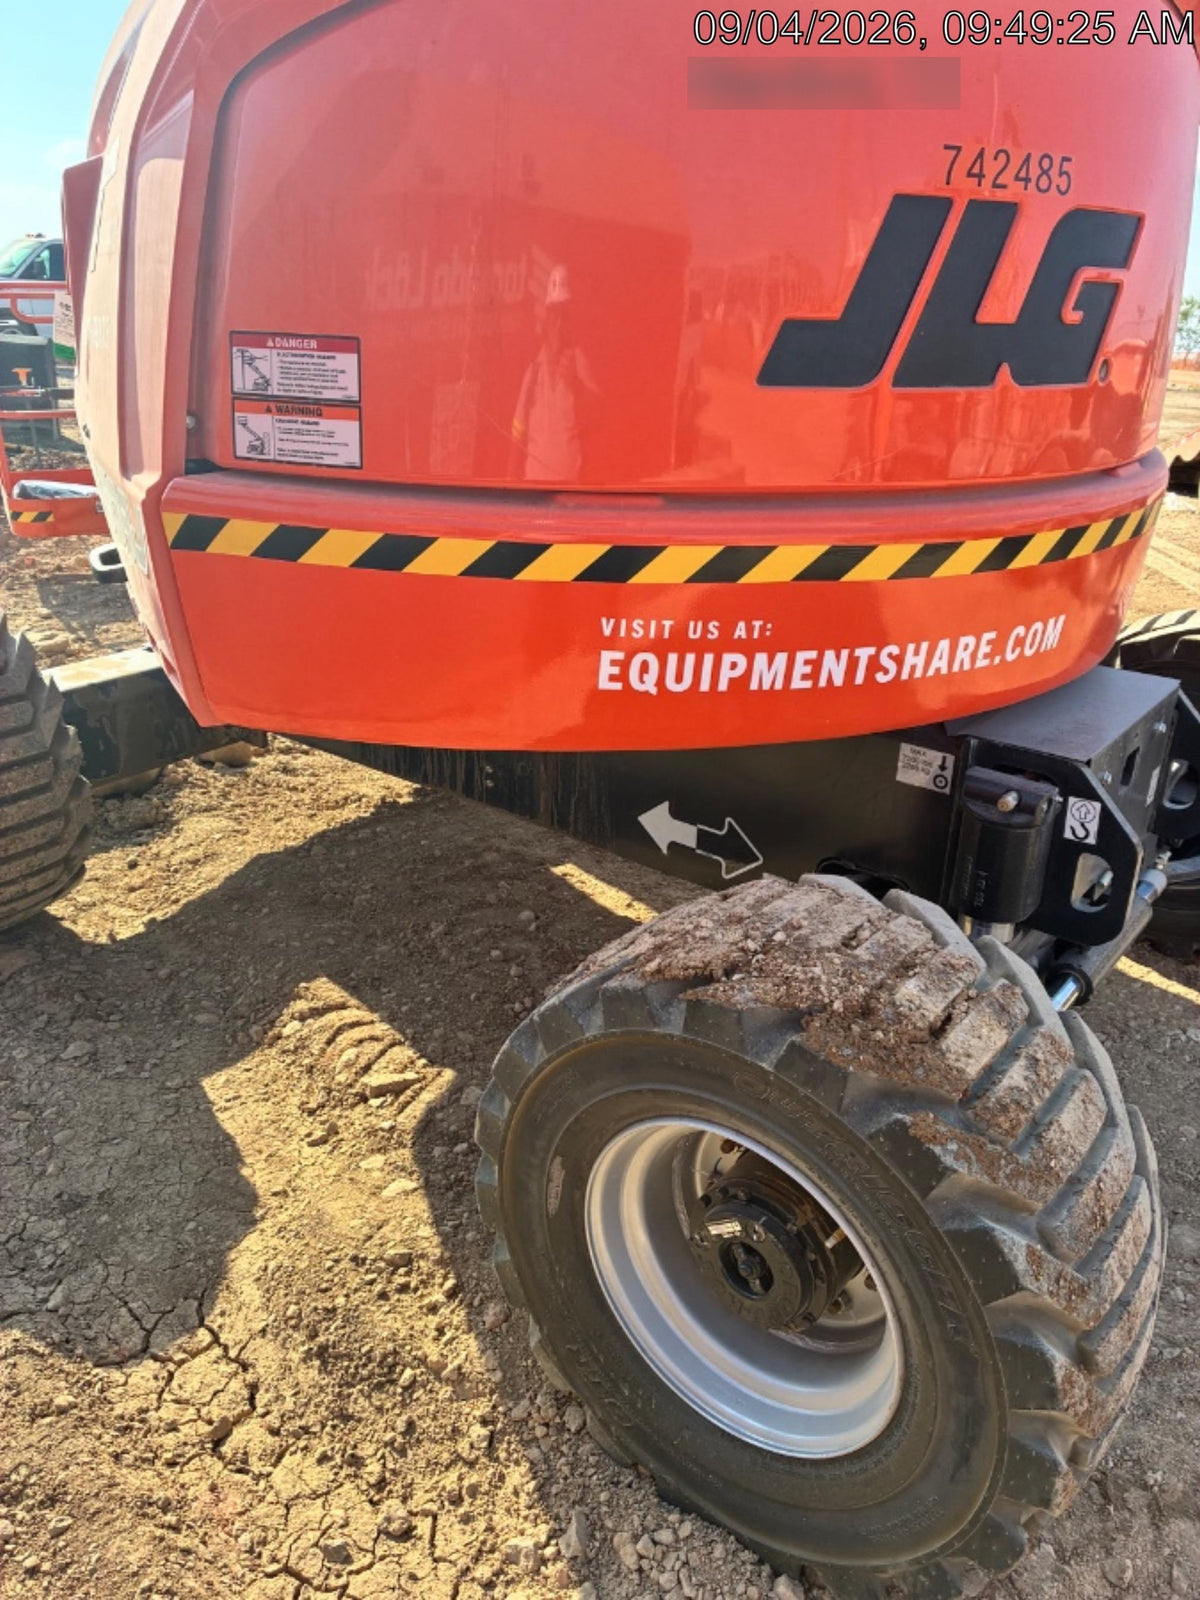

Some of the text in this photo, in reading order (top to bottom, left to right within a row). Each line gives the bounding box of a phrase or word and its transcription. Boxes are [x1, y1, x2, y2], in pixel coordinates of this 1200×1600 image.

[942, 143, 1073, 196] 742485
[756, 193, 1144, 388] JLG
[275, 337, 318, 349] DANGER
[275, 404, 323, 417] WARNING
[600, 617, 773, 639] VISIT US AT:
[598, 614, 1066, 695] EQUIPMENTSHARE.COM
